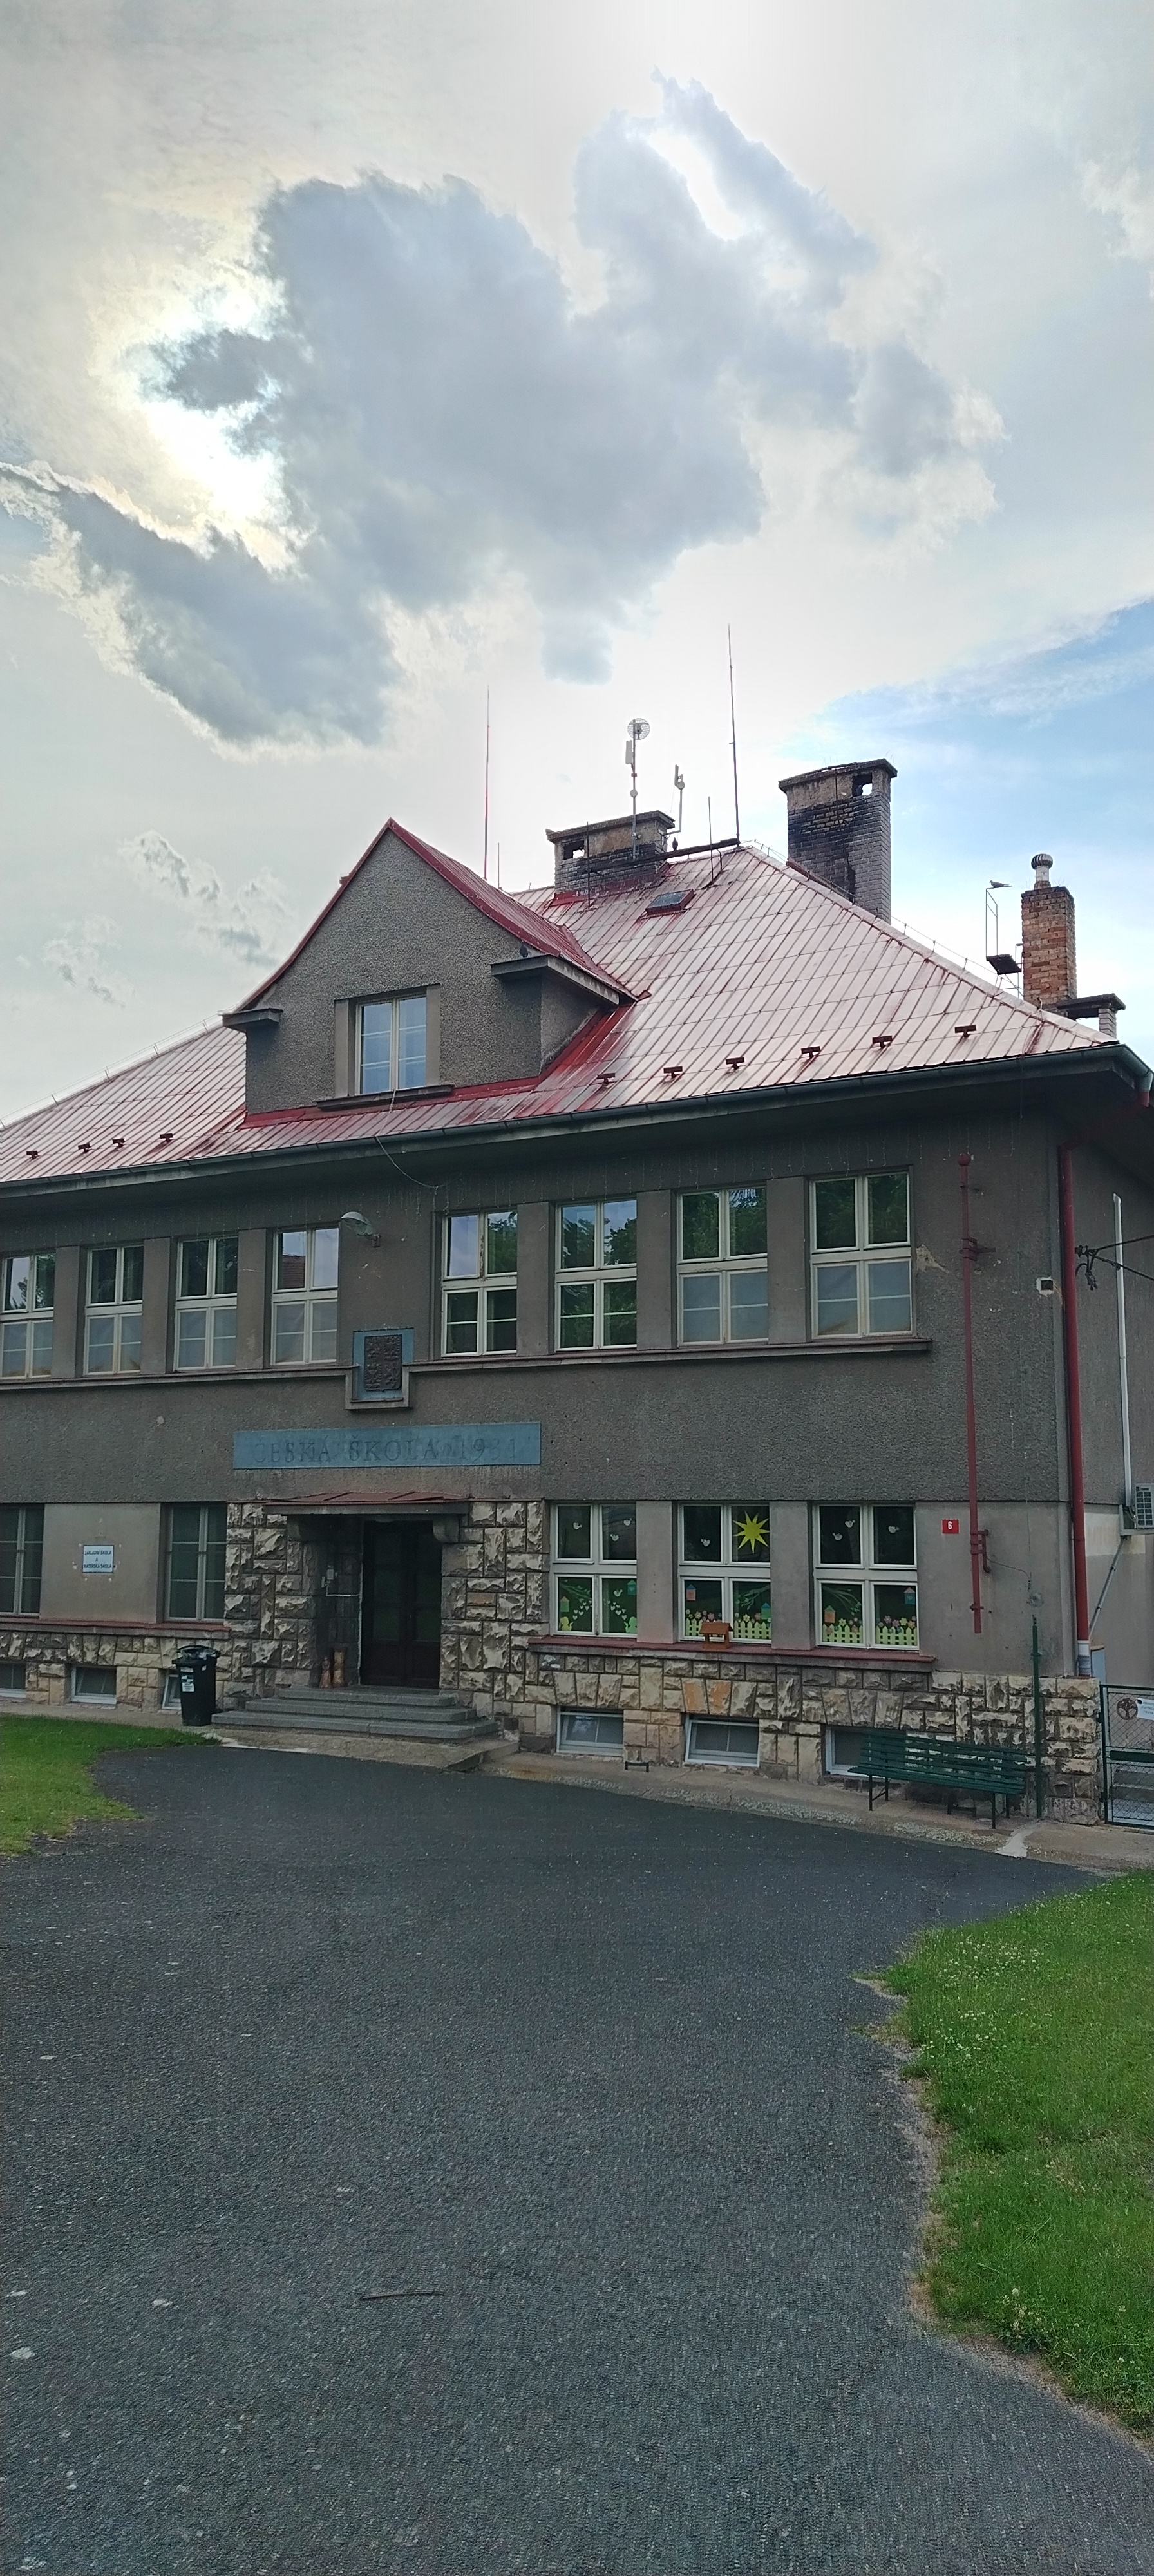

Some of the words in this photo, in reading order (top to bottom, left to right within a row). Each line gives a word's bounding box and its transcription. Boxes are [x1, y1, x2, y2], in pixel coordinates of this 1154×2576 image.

[254, 1435, 332, 1463] ČESKÁ
[348, 1434, 438, 1462] ŠKOLA
[948, 1521, 952, 1530] 6
